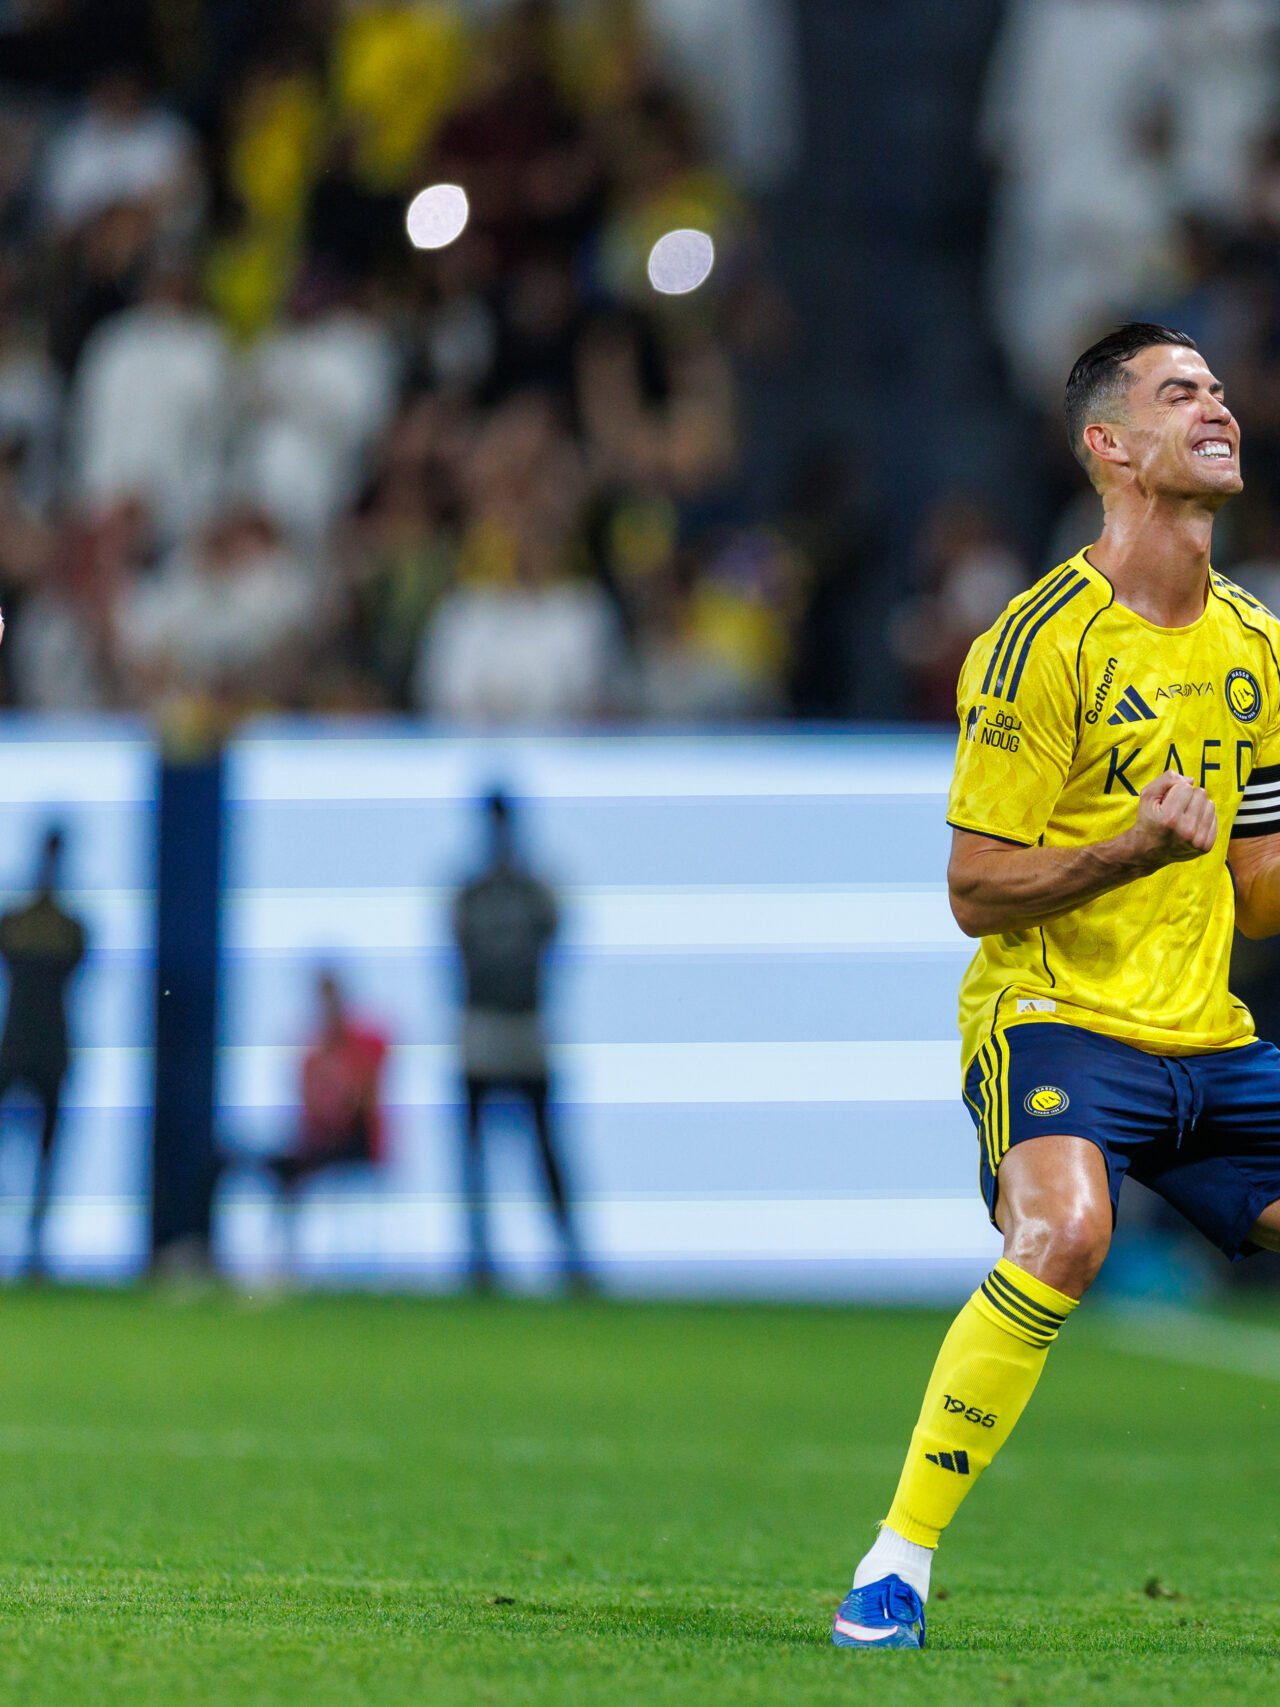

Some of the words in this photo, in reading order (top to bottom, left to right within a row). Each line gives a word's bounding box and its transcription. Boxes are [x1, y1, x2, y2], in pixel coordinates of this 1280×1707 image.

[1085, 657, 1118, 725] Gathern
[1155, 681, 1215, 701] AROYA
[980, 727, 1020, 753] NOUG
[943, 1395, 998, 1428] 1955
